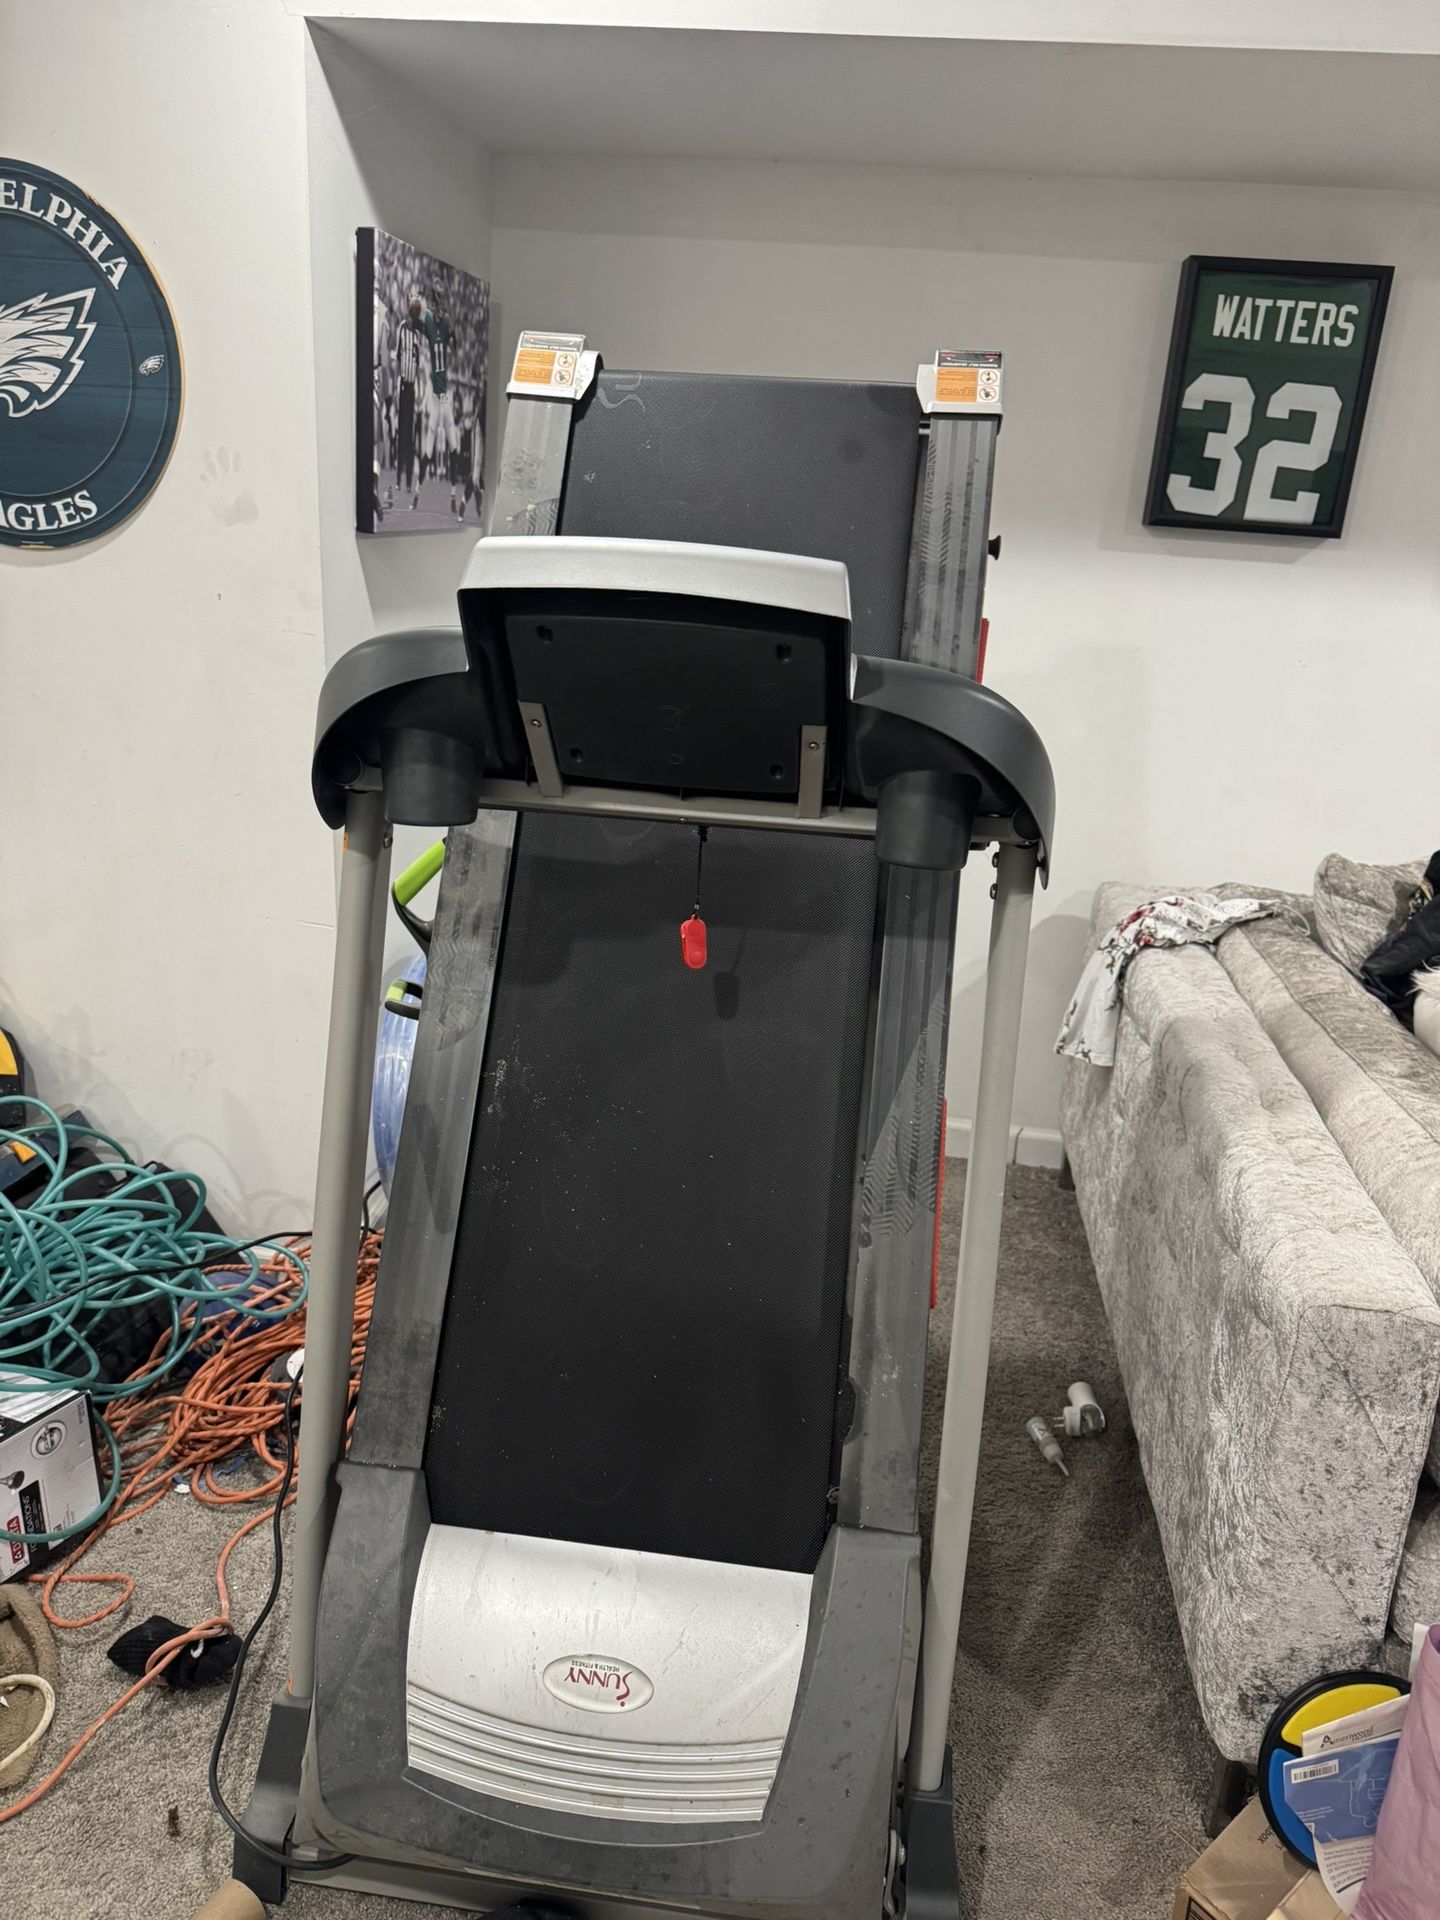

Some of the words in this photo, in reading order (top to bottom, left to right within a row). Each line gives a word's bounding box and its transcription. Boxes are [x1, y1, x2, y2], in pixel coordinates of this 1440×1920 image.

[1212, 293, 1359, 347] WATTERS
[1166, 372, 1343, 525] 32
[571, 1660, 593, 1669] FITNESS
[598, 1664, 620, 1672] HEALTH
[564, 1667, 633, 1707] SUNNY
